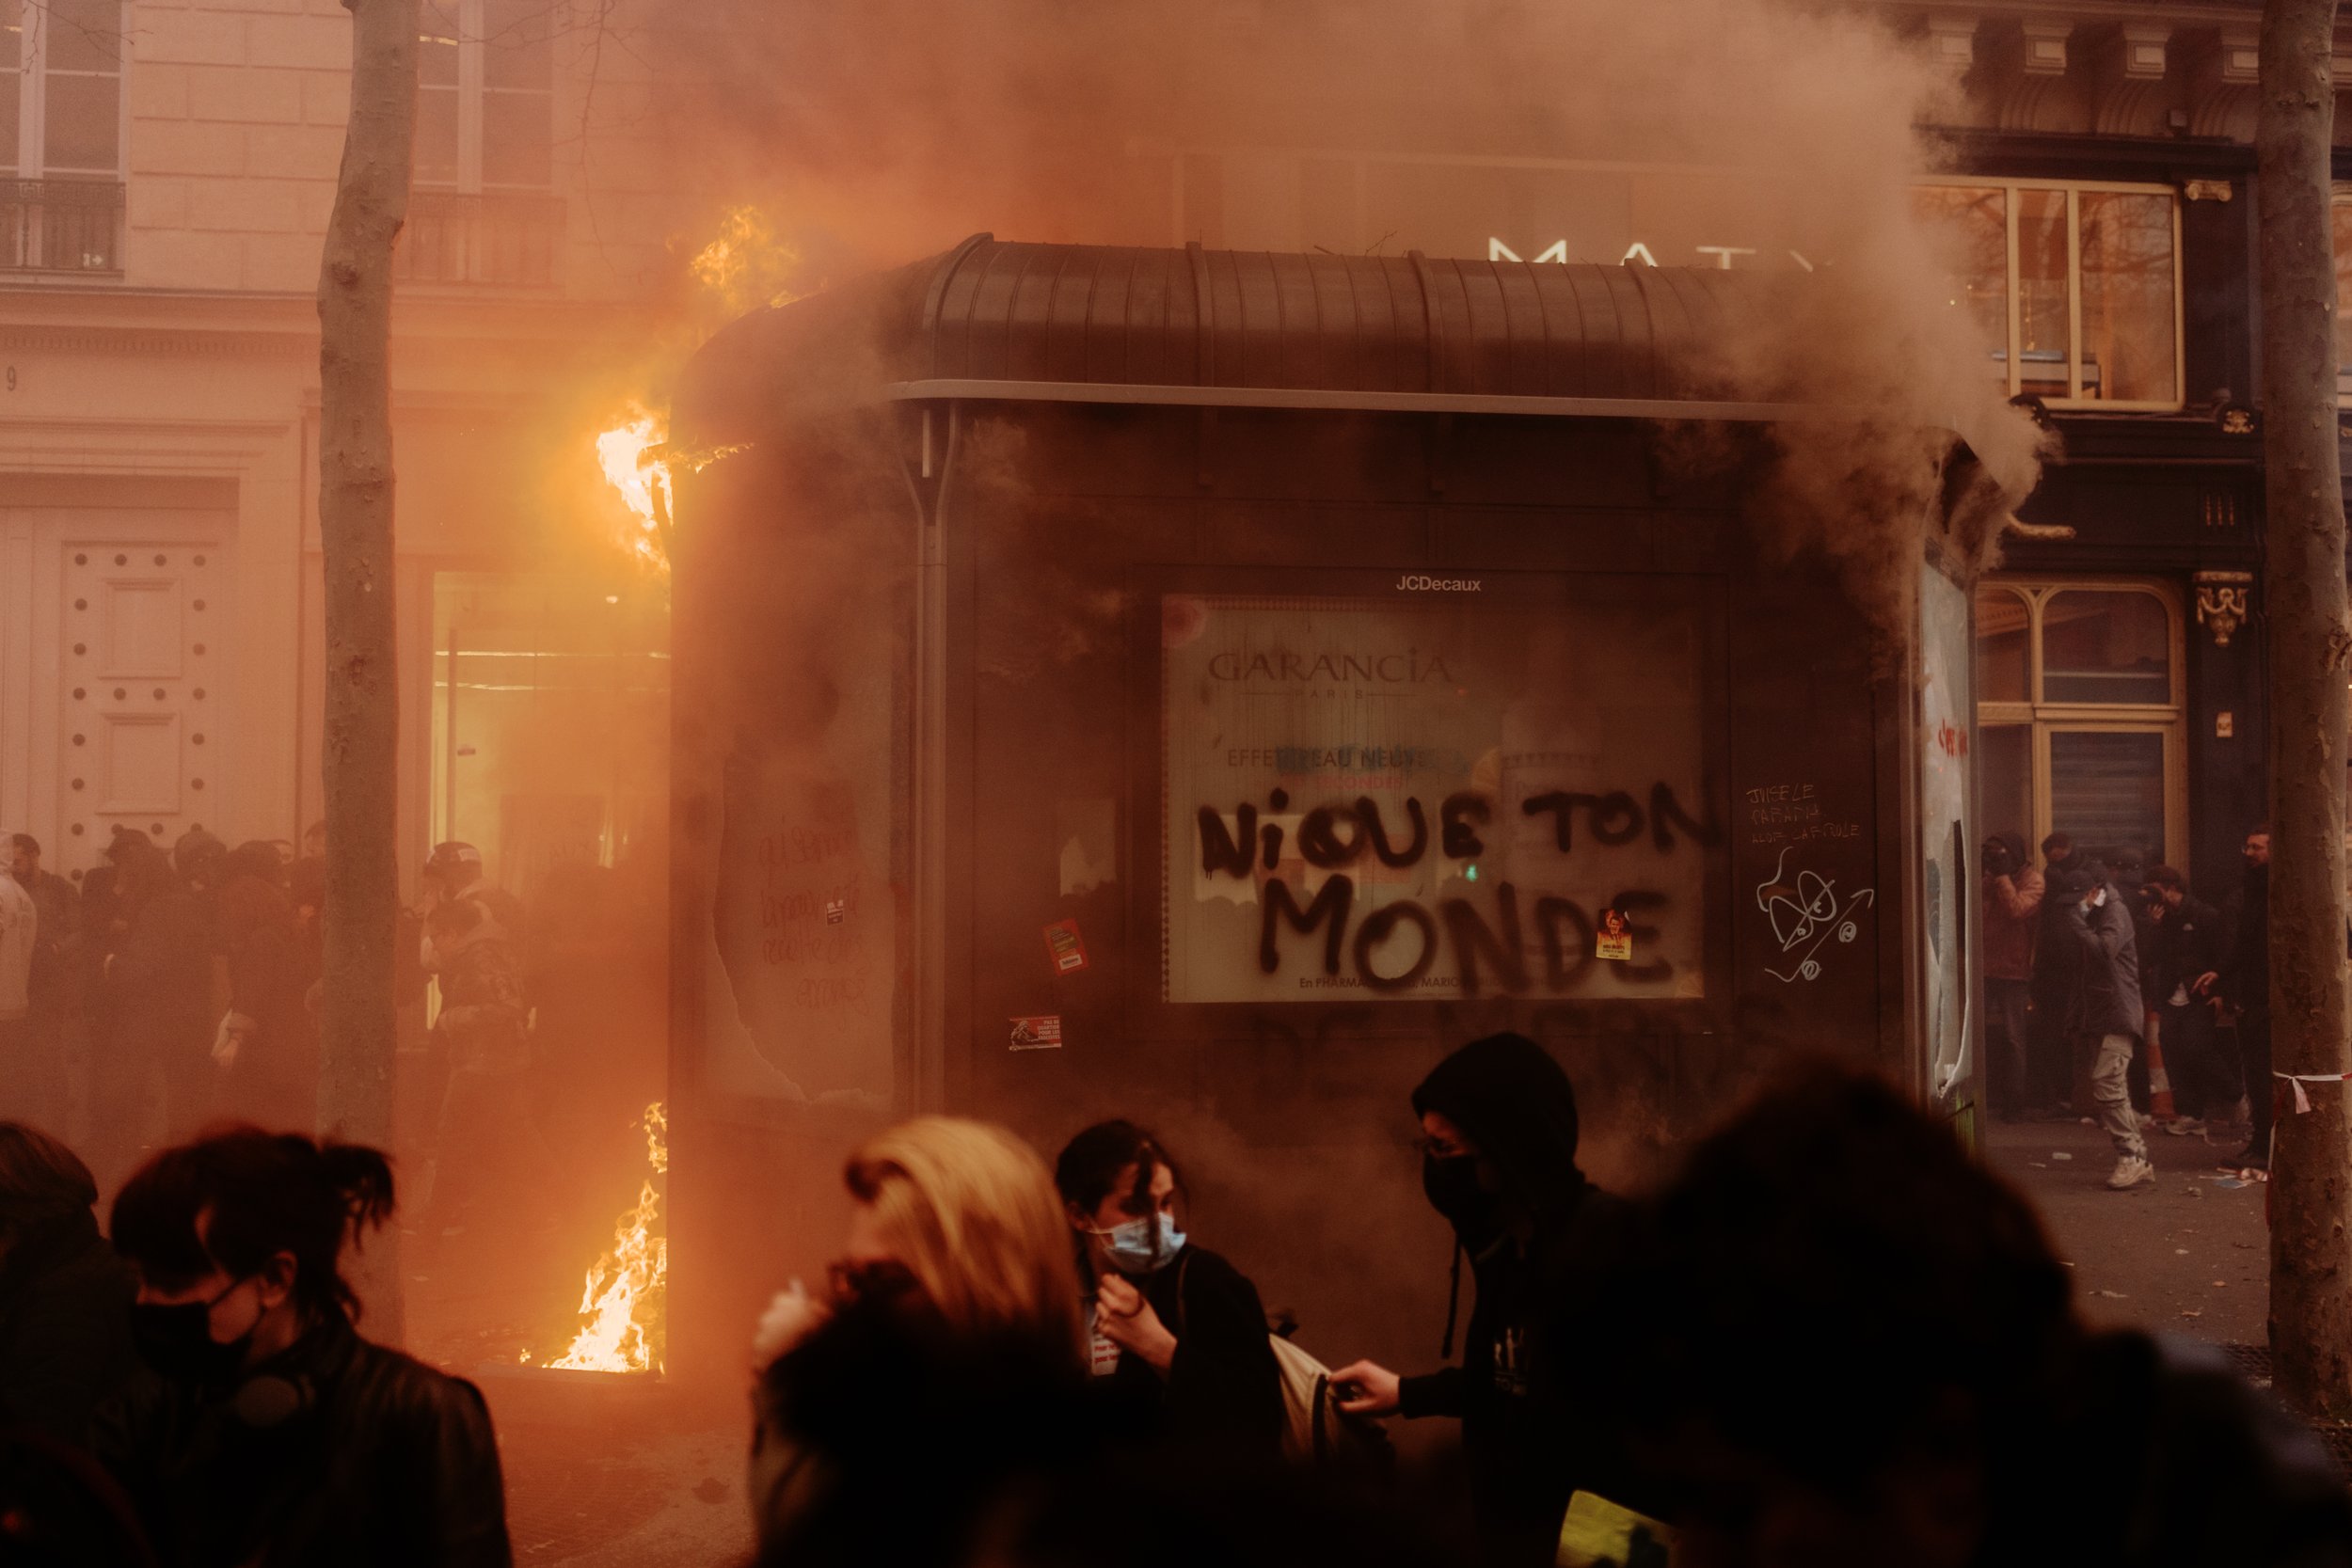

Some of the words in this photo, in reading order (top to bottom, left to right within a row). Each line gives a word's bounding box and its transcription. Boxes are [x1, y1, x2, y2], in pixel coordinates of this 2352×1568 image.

[7, 365, 17, 391] 9
[1396, 575, 1482, 592] JCDecaux
[1522, 781, 1725, 852] TON
[1259, 873, 1675, 997] MONDE
[1299, 977, 1312, 988] En
